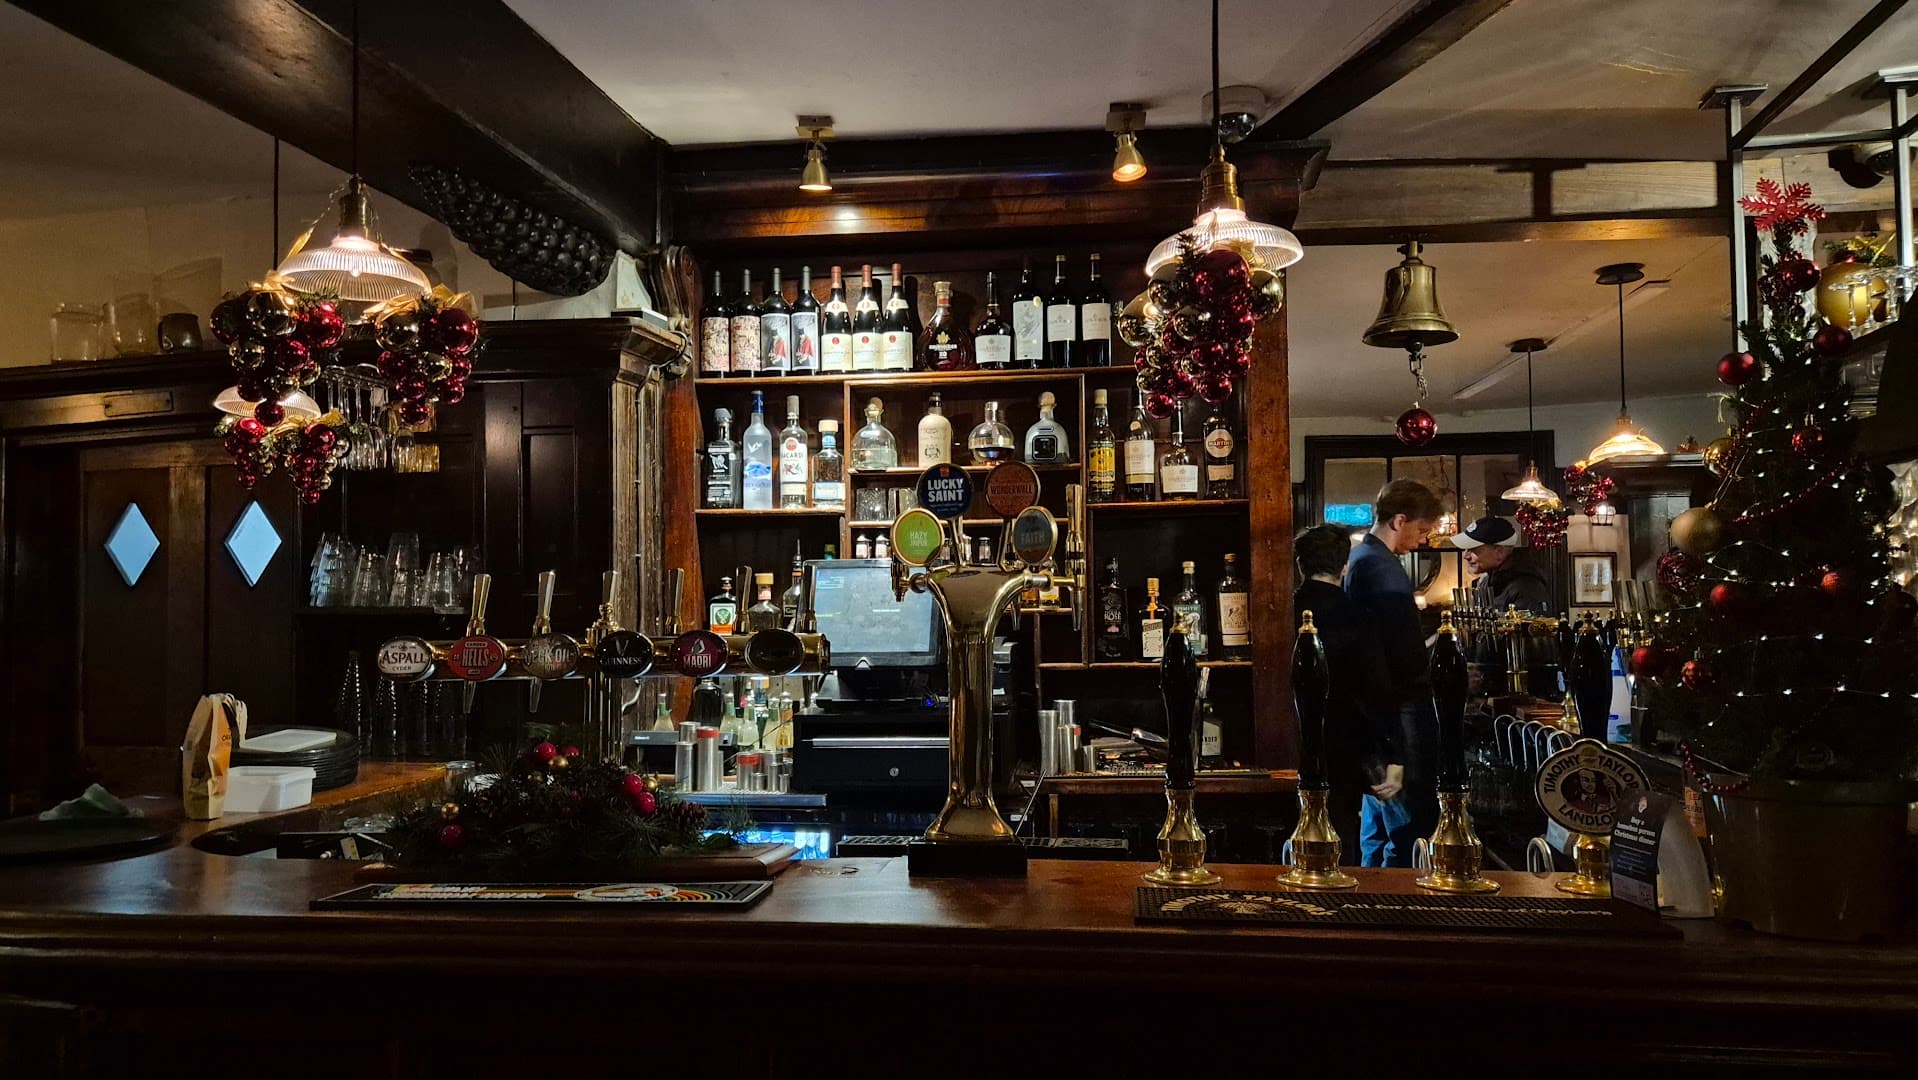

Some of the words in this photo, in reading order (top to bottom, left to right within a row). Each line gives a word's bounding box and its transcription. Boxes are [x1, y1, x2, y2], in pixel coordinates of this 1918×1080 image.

[928, 479, 964, 490] LUCKY
[928, 489, 964, 502] SAINT
[381, 650, 427, 664] ASPALL
[462, 649, 489, 666] HELLS
[600, 656, 641, 665] GUINNESS
[1543, 754, 1580, 794] TIMOTHY
